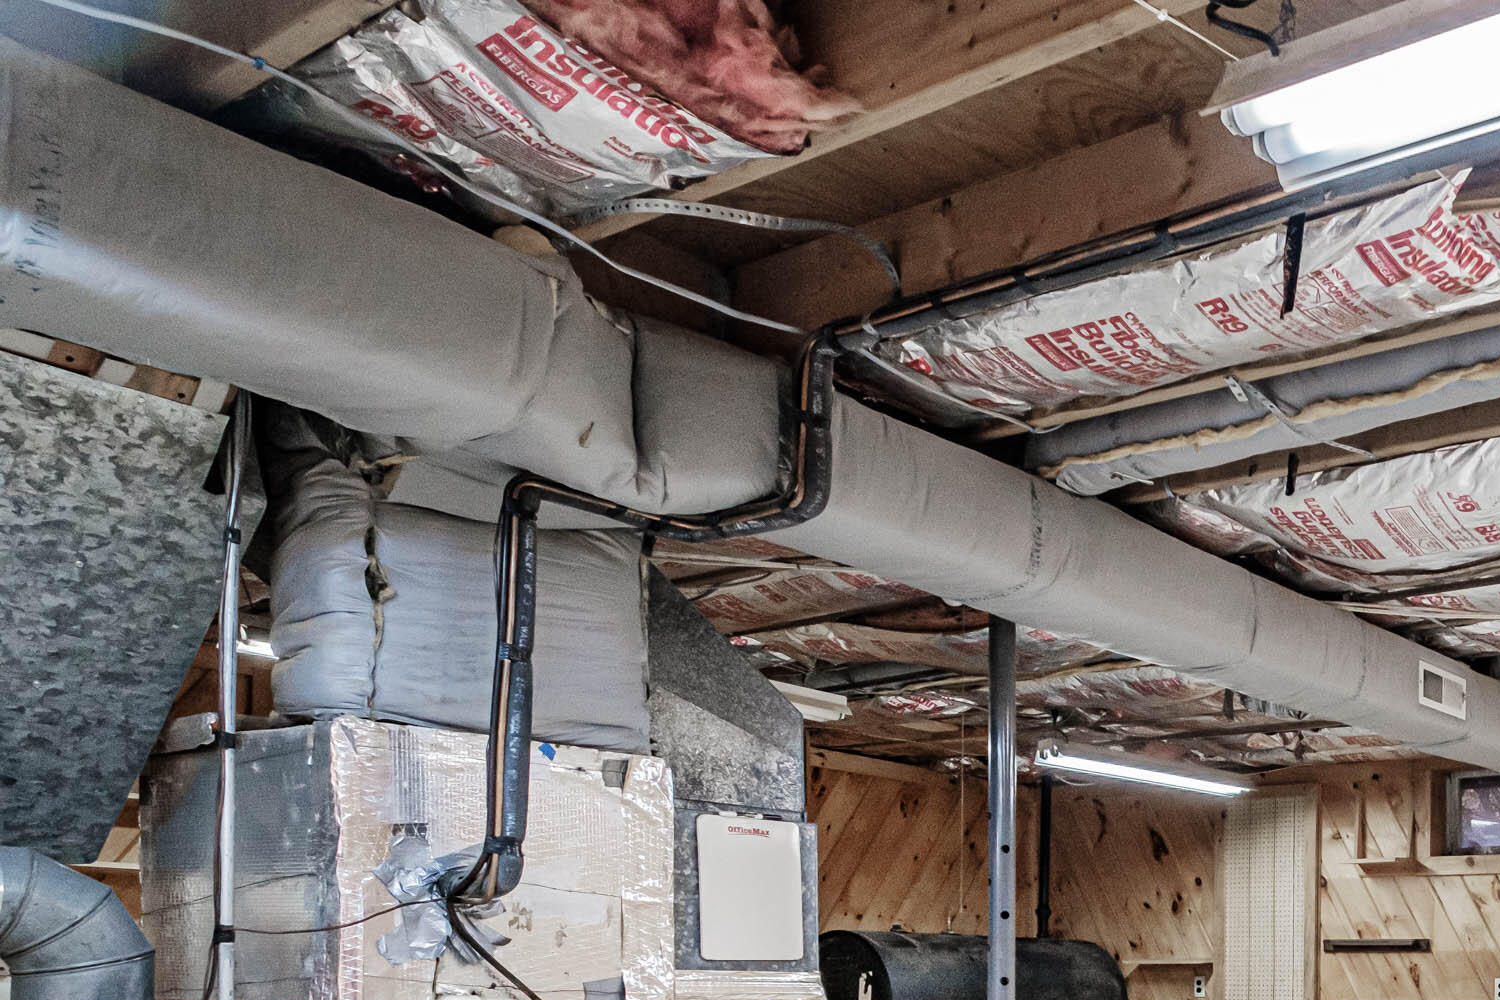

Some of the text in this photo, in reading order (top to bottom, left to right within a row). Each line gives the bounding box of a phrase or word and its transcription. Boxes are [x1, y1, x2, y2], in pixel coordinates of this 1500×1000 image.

[485, 42, 564, 106] FIBERGLAS
[1199, 296, 1249, 334] R-19
[727, 825, 770, 837] OfficeMax
